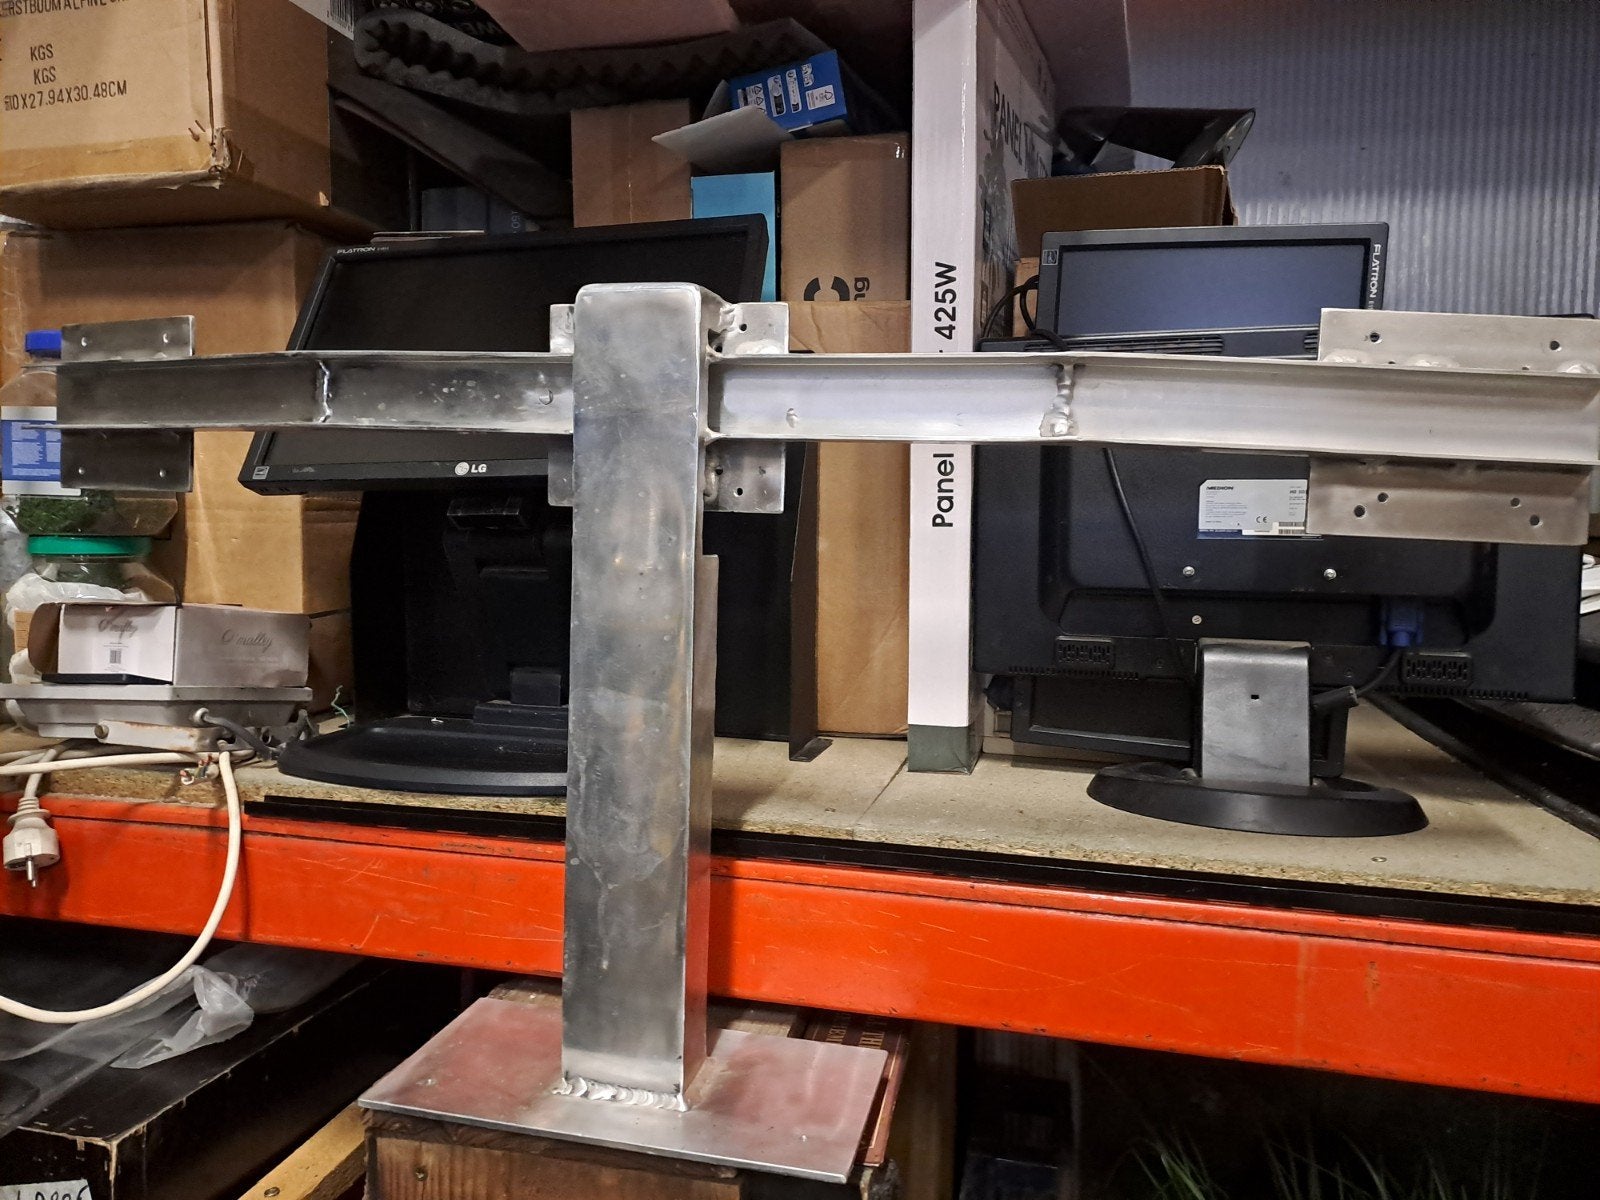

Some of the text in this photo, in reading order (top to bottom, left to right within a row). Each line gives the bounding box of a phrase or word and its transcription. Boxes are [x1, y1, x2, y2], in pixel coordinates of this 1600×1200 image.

[30, 43, 54, 62] KGS
[33, 66, 57, 85] KGS
[1369, 243, 1381, 298] FLATRON
[931, 261, 957, 528] Panel 425W
[470, 463, 488, 474] LG
